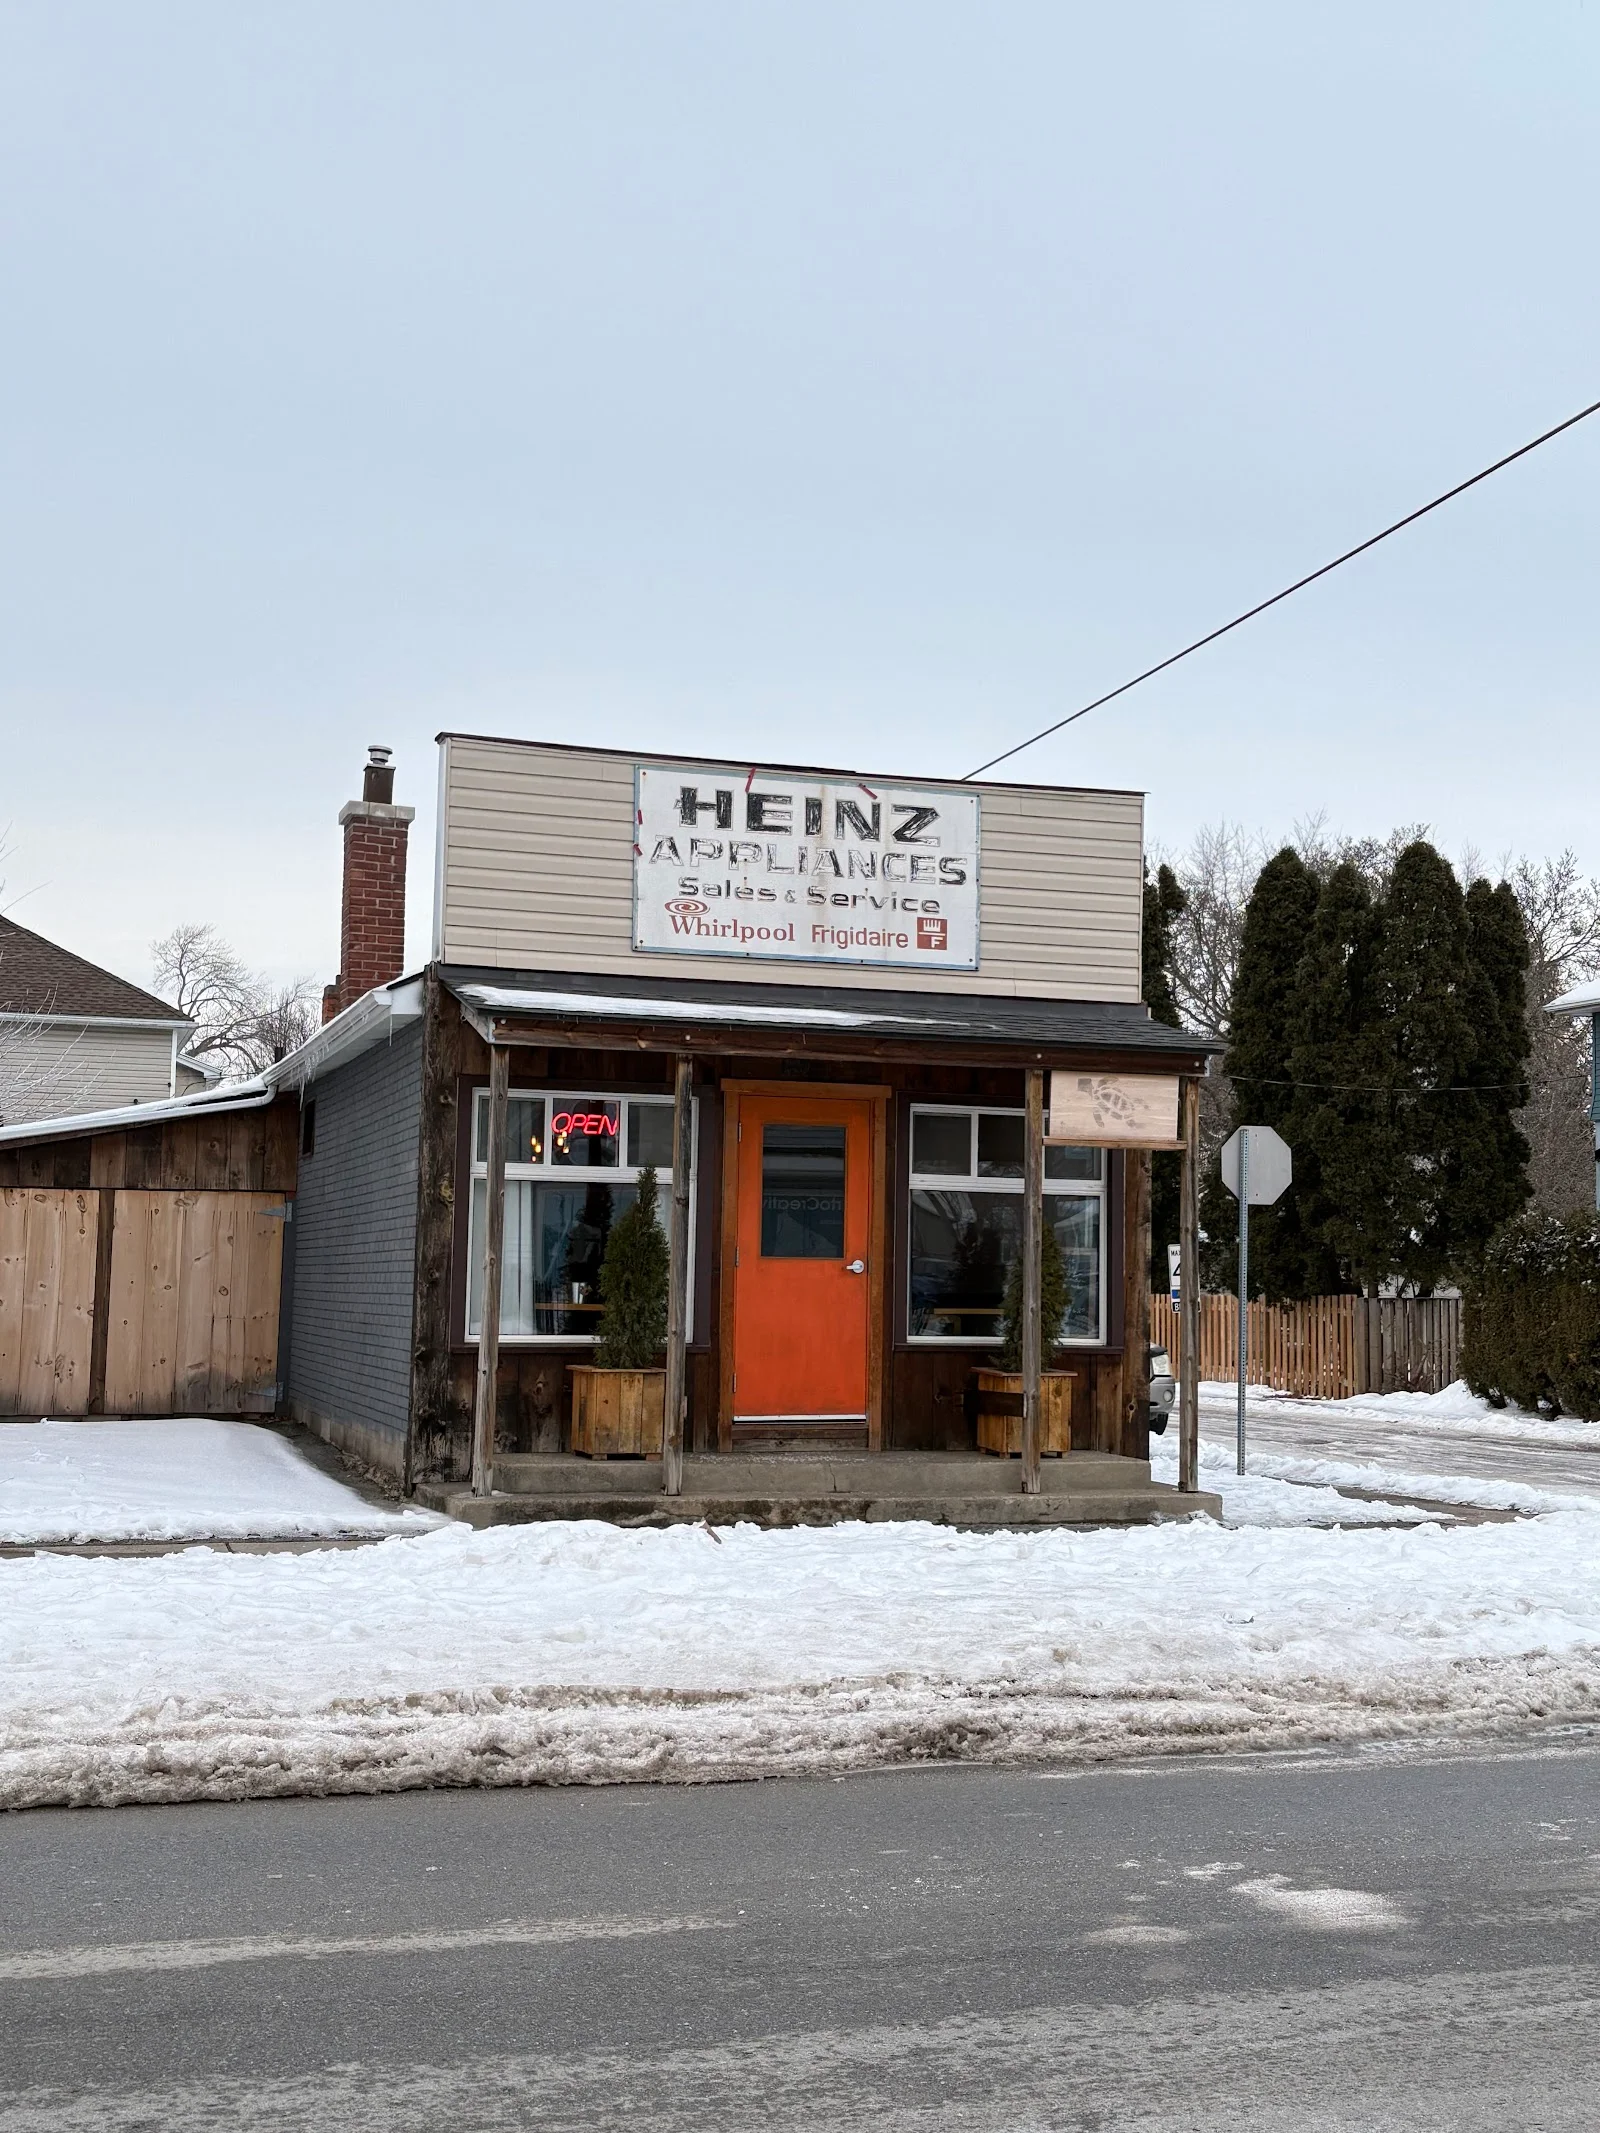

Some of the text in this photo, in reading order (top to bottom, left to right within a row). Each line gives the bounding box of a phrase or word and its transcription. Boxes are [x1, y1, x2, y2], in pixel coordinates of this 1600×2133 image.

[673, 786, 941, 847] HEINZ
[649, 834, 968, 886] APPLIANCES
[678, 876, 941, 914] Sales & Service
[669, 914, 796, 943] Whirlpool
[811, 924, 909, 950] Frigidaire
[551, 1112, 618, 1136] OPEN
